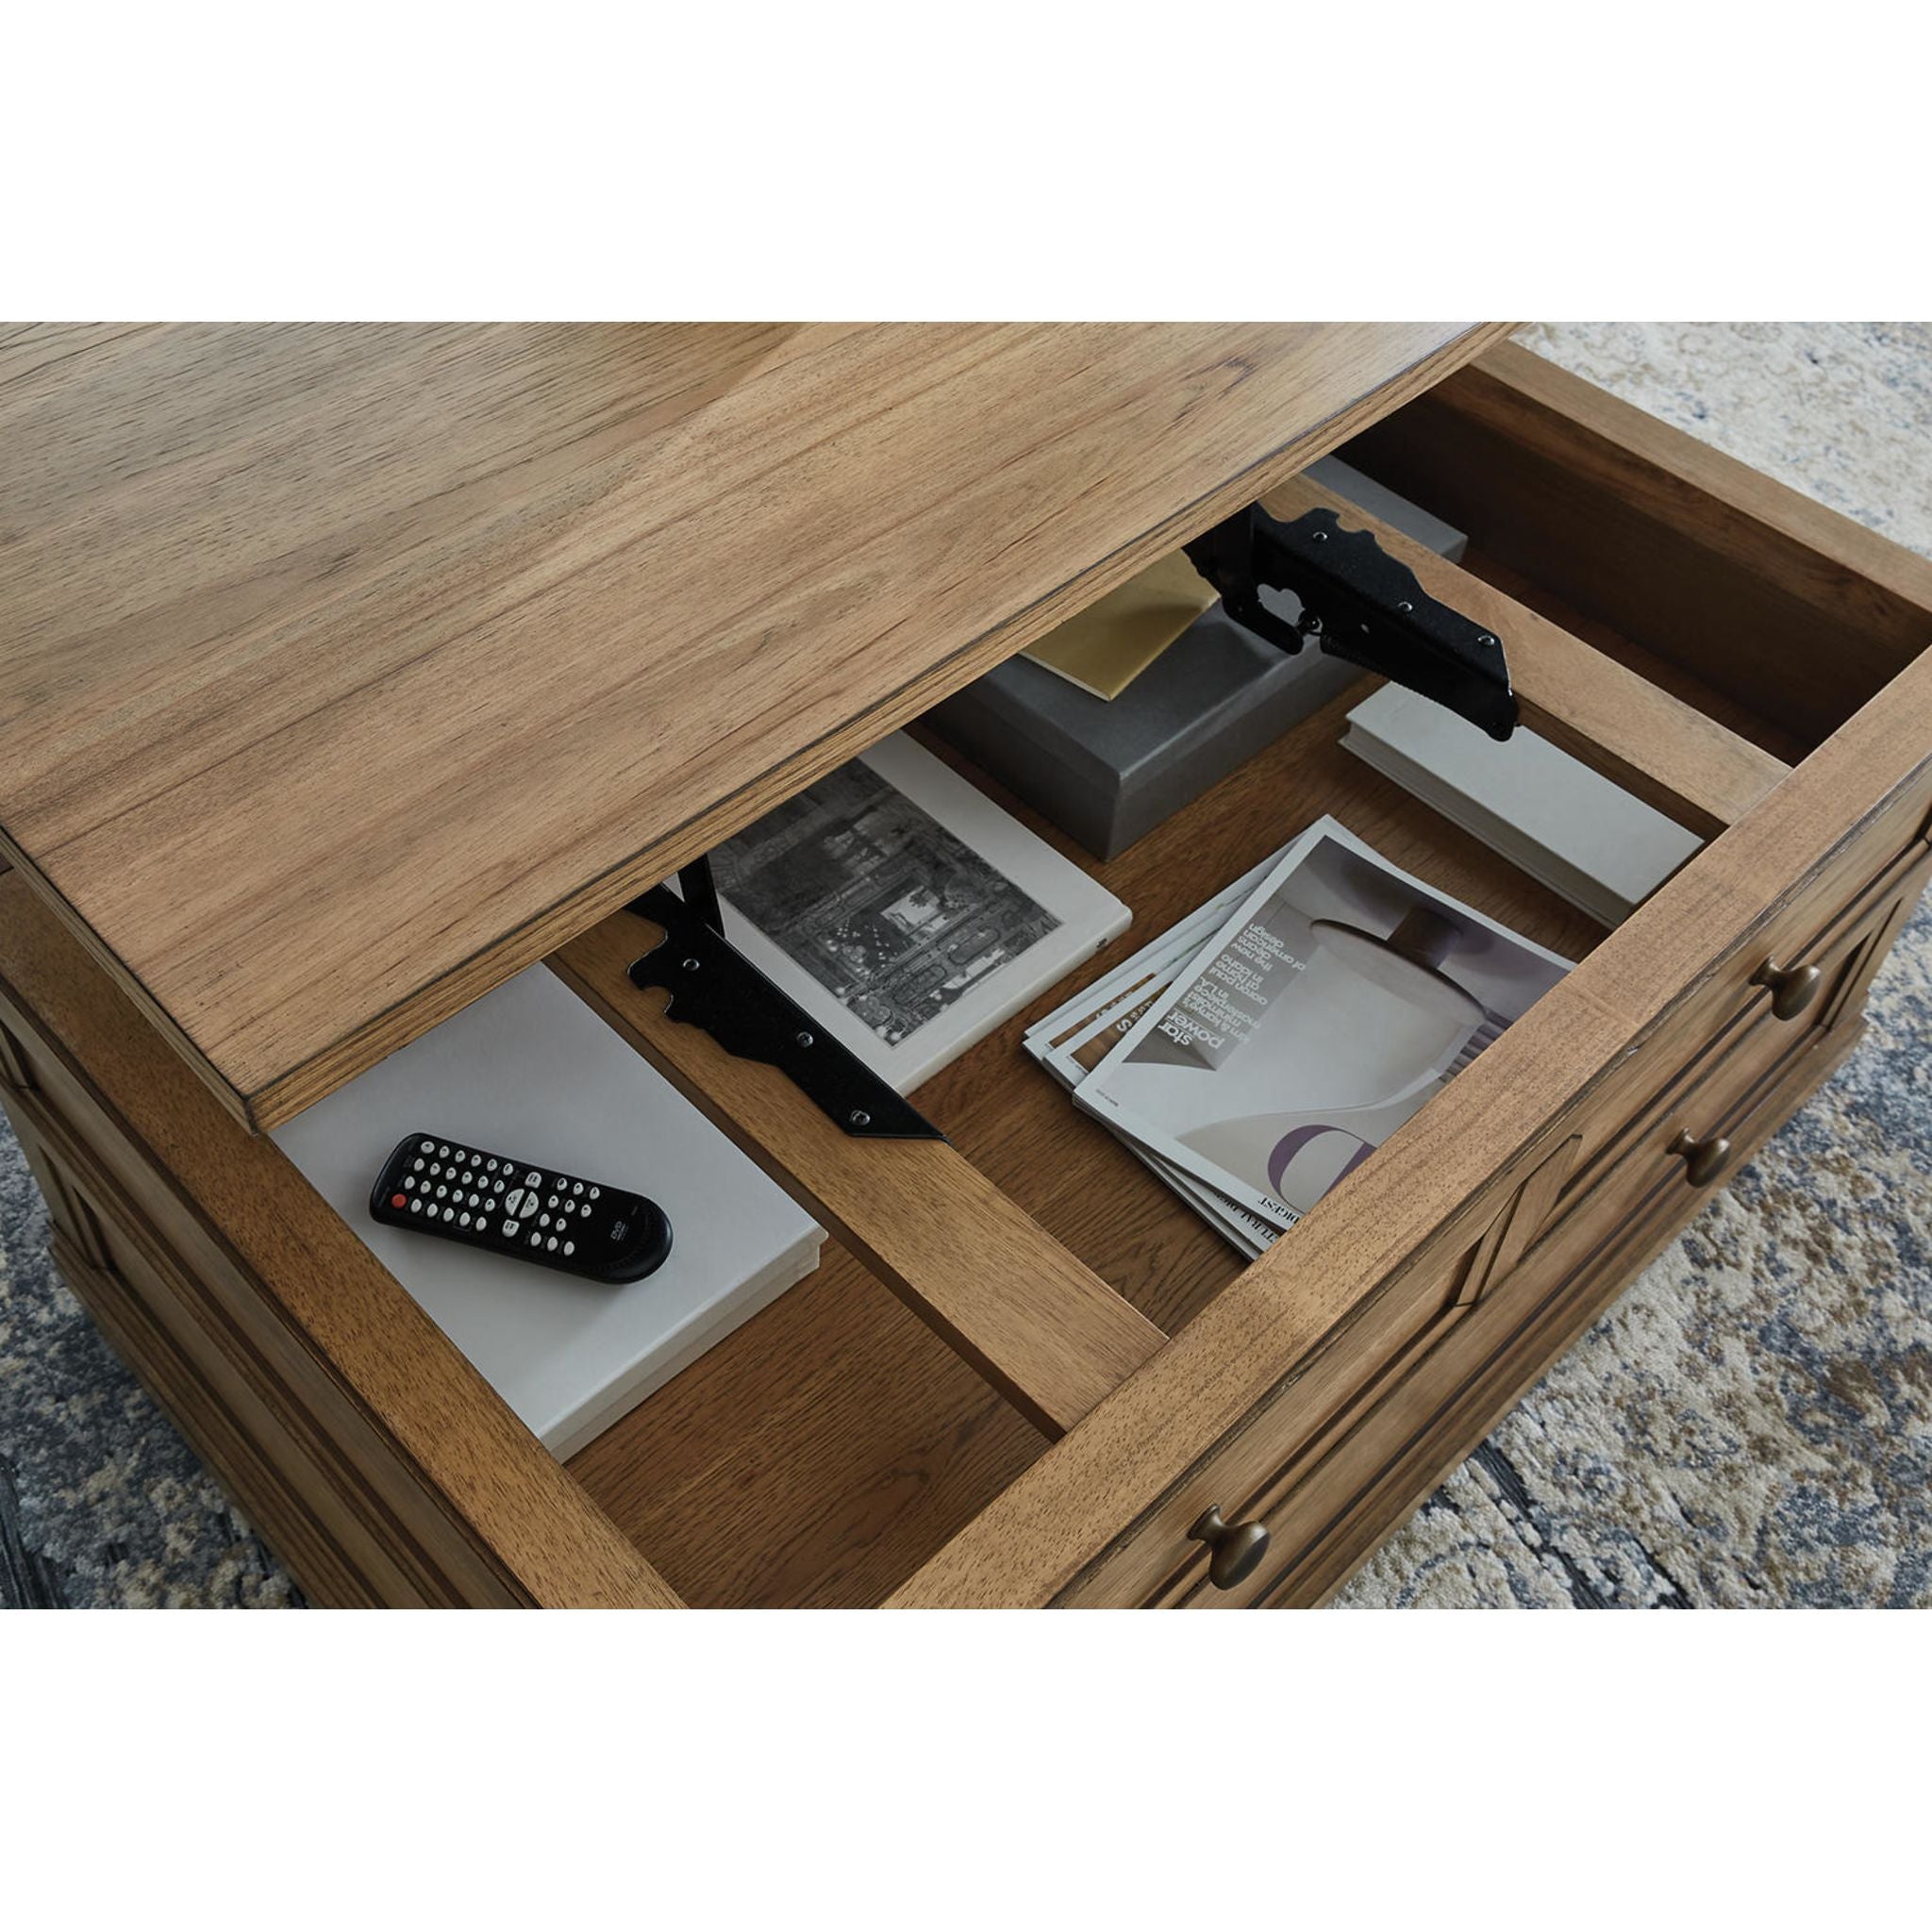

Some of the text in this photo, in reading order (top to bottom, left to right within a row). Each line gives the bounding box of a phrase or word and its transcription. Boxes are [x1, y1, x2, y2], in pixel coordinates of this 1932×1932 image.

[1237, 936, 1272, 960] deans
[1242, 929, 1307, 971] of american
[1248, 924, 1285, 949] design
[1221, 954, 1253, 976] idaho
[1230, 942, 1273, 972] the new
[1208, 967, 1269, 1006] aaron paul
[1215, 960, 1259, 991] at home
[1187, 991, 1242, 1027] minimalist
[1193, 984, 1261, 1029] masterpiece
[1157, 1021, 1193, 1046] star
[1167, 1011, 1224, 1049] power
[1257, 1197, 1300, 1224] DIGEST
